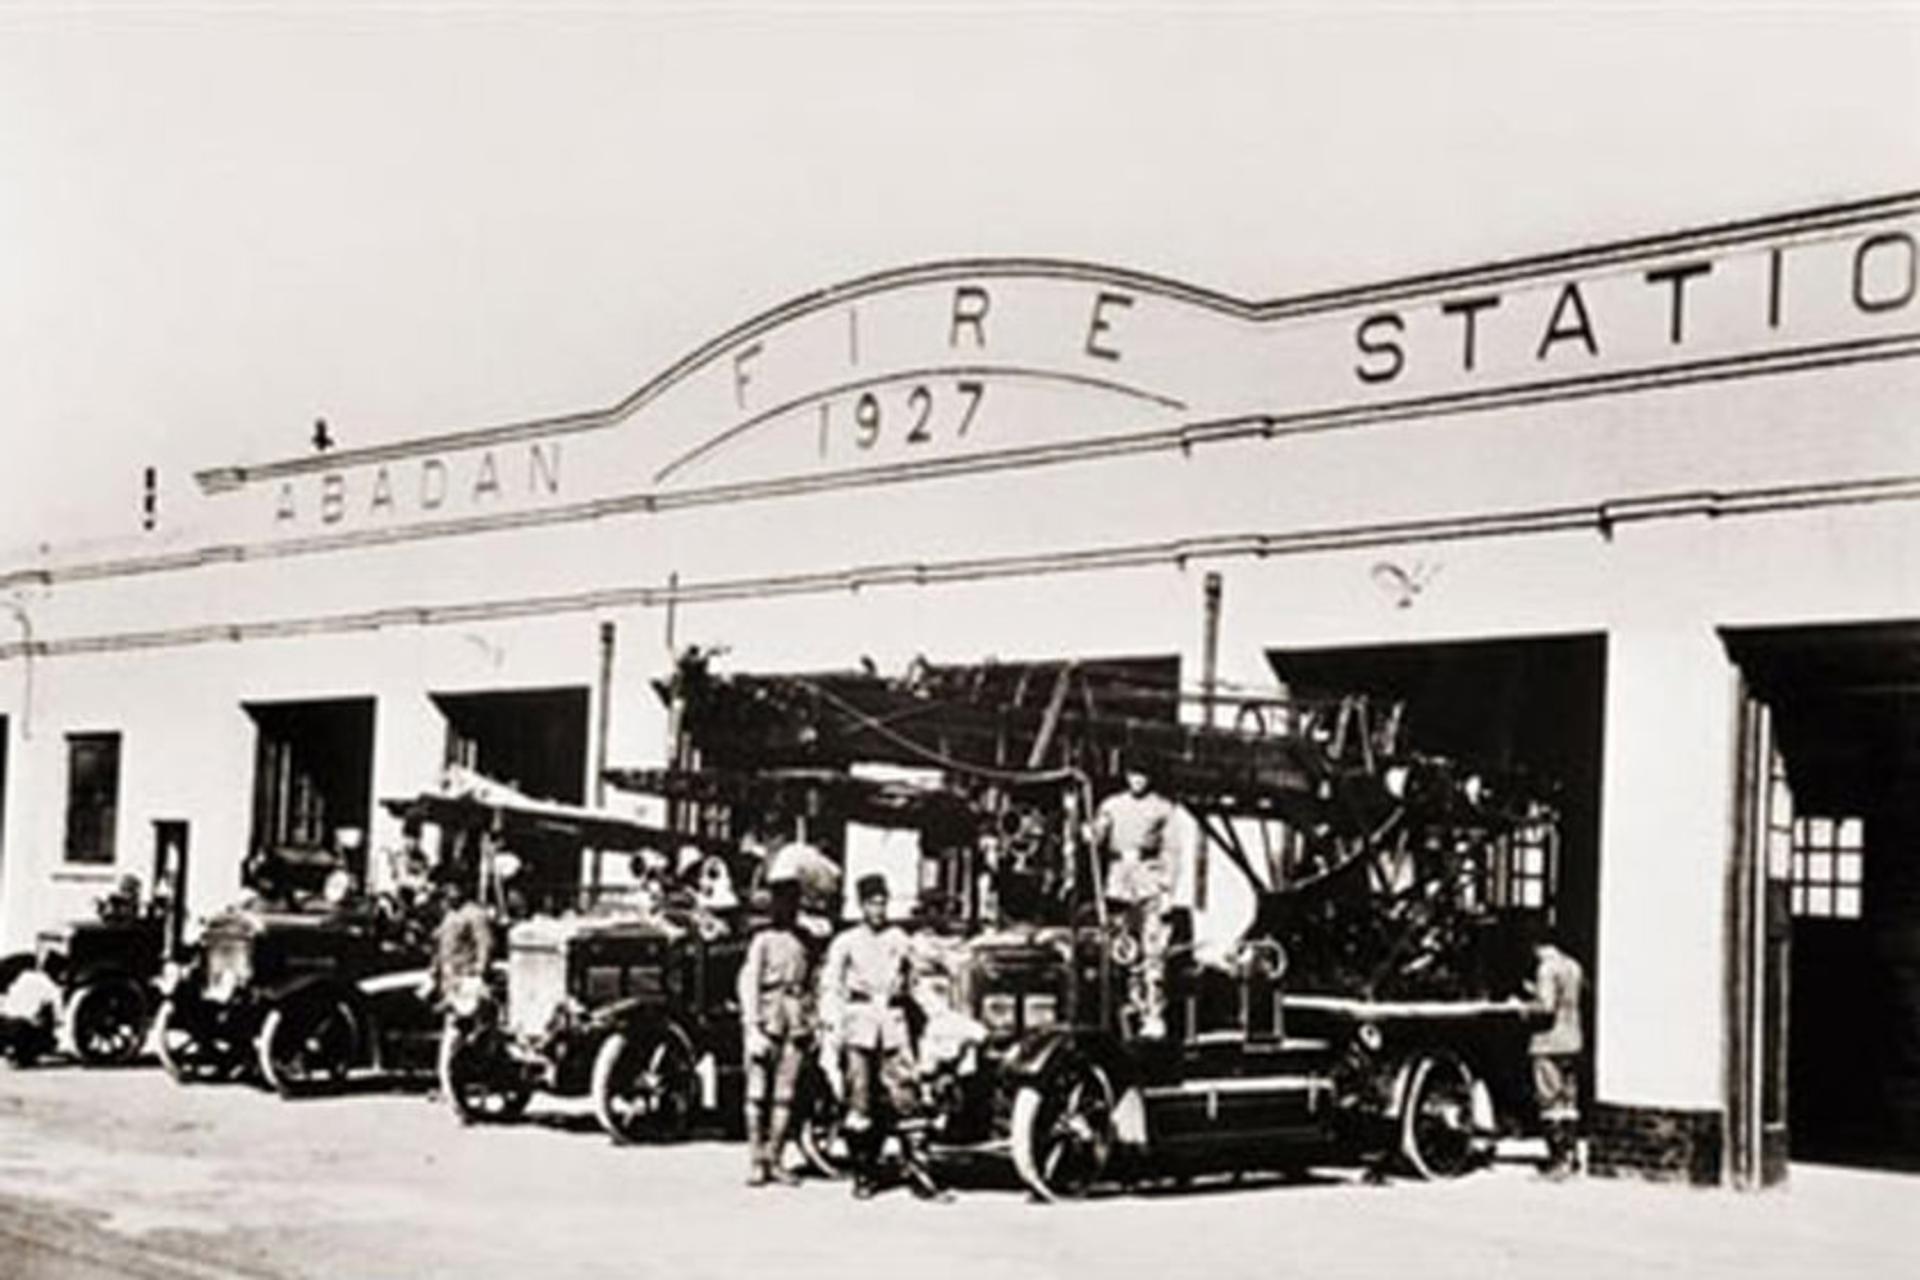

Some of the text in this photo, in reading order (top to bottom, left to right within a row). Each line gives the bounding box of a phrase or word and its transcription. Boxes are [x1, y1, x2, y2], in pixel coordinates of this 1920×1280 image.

[273, 231, 1918, 525] ABADAN FIRE STATIO
[818, 382, 984, 459] 1927
